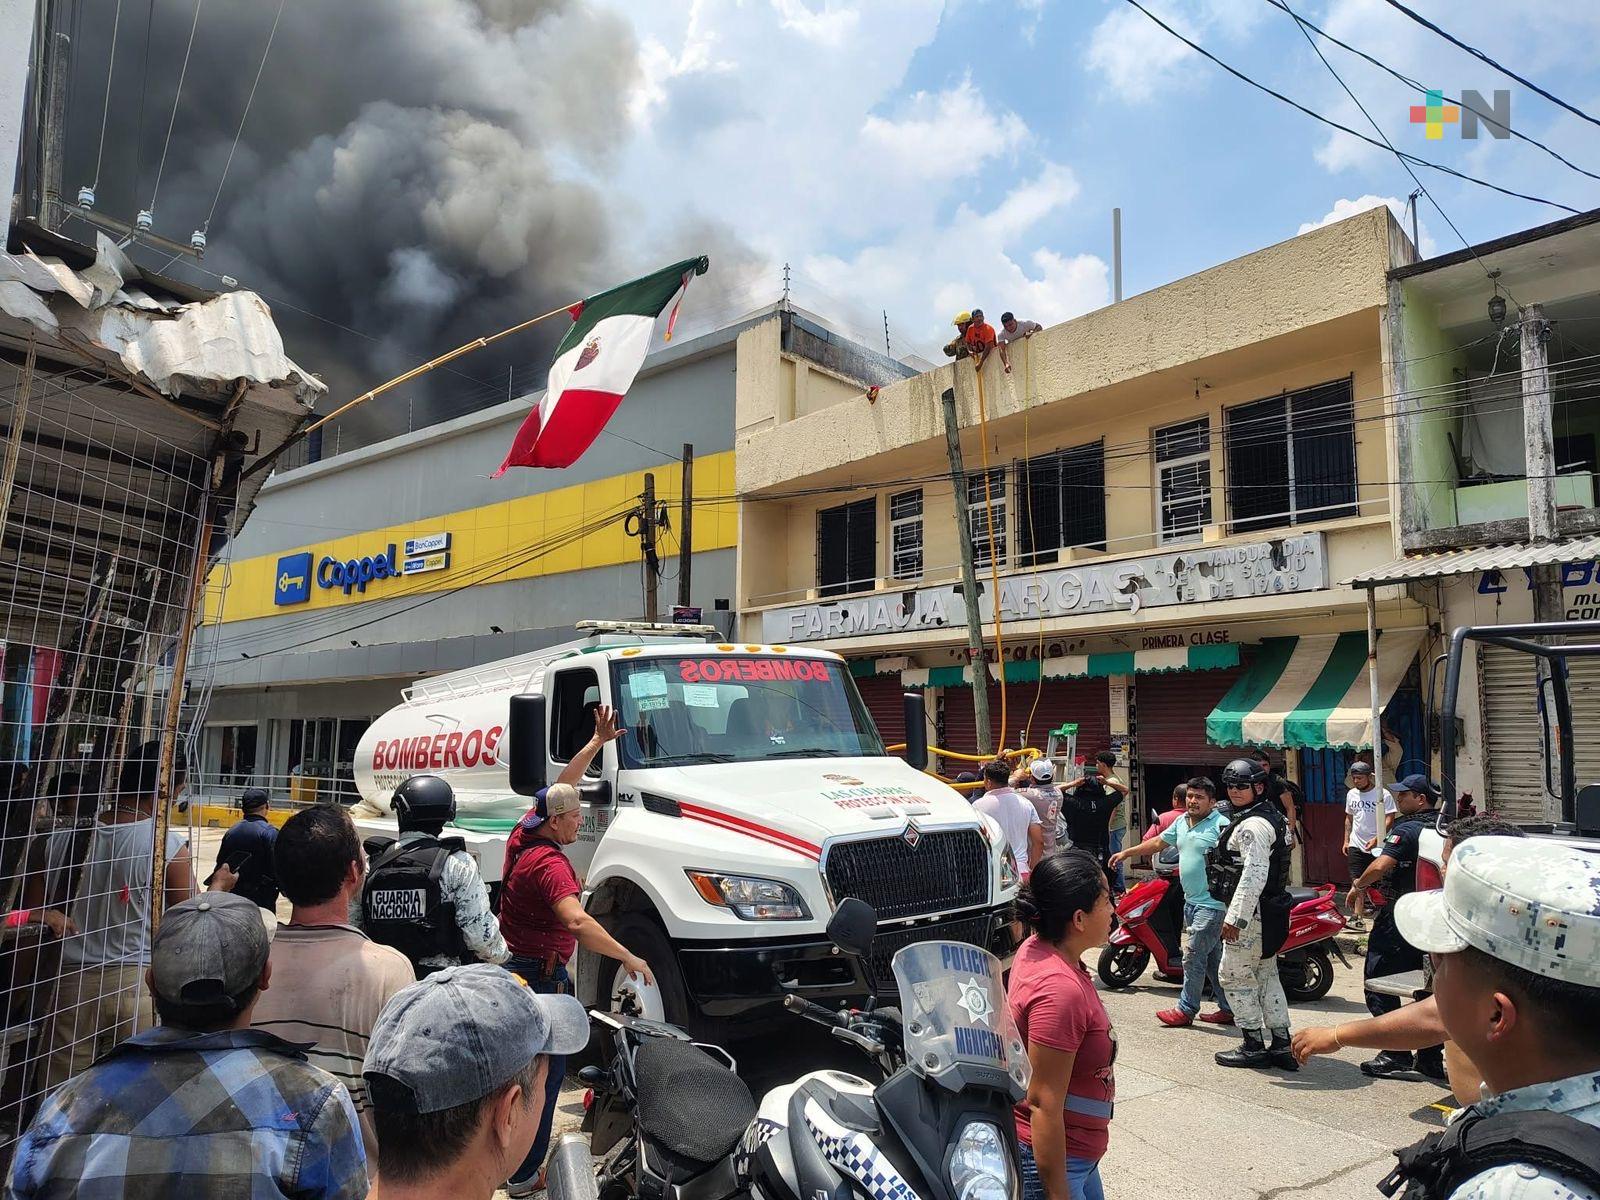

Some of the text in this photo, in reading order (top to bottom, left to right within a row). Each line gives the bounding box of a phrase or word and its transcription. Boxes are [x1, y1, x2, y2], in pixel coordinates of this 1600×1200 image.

[1207, 538, 1315, 567] VANGUADIA
[991, 563, 1144, 615] ARGAS
[1250, 573, 1300, 596] 1968
[1141, 630, 1230, 650] PRIMERA CLASE
[372, 725, 503, 770] BOMBEROS
[374, 890, 421, 905] GUARDIA
[372, 903, 424, 919] NACIONAL
[954, 1026, 1007, 1062] MUNICIPAL
